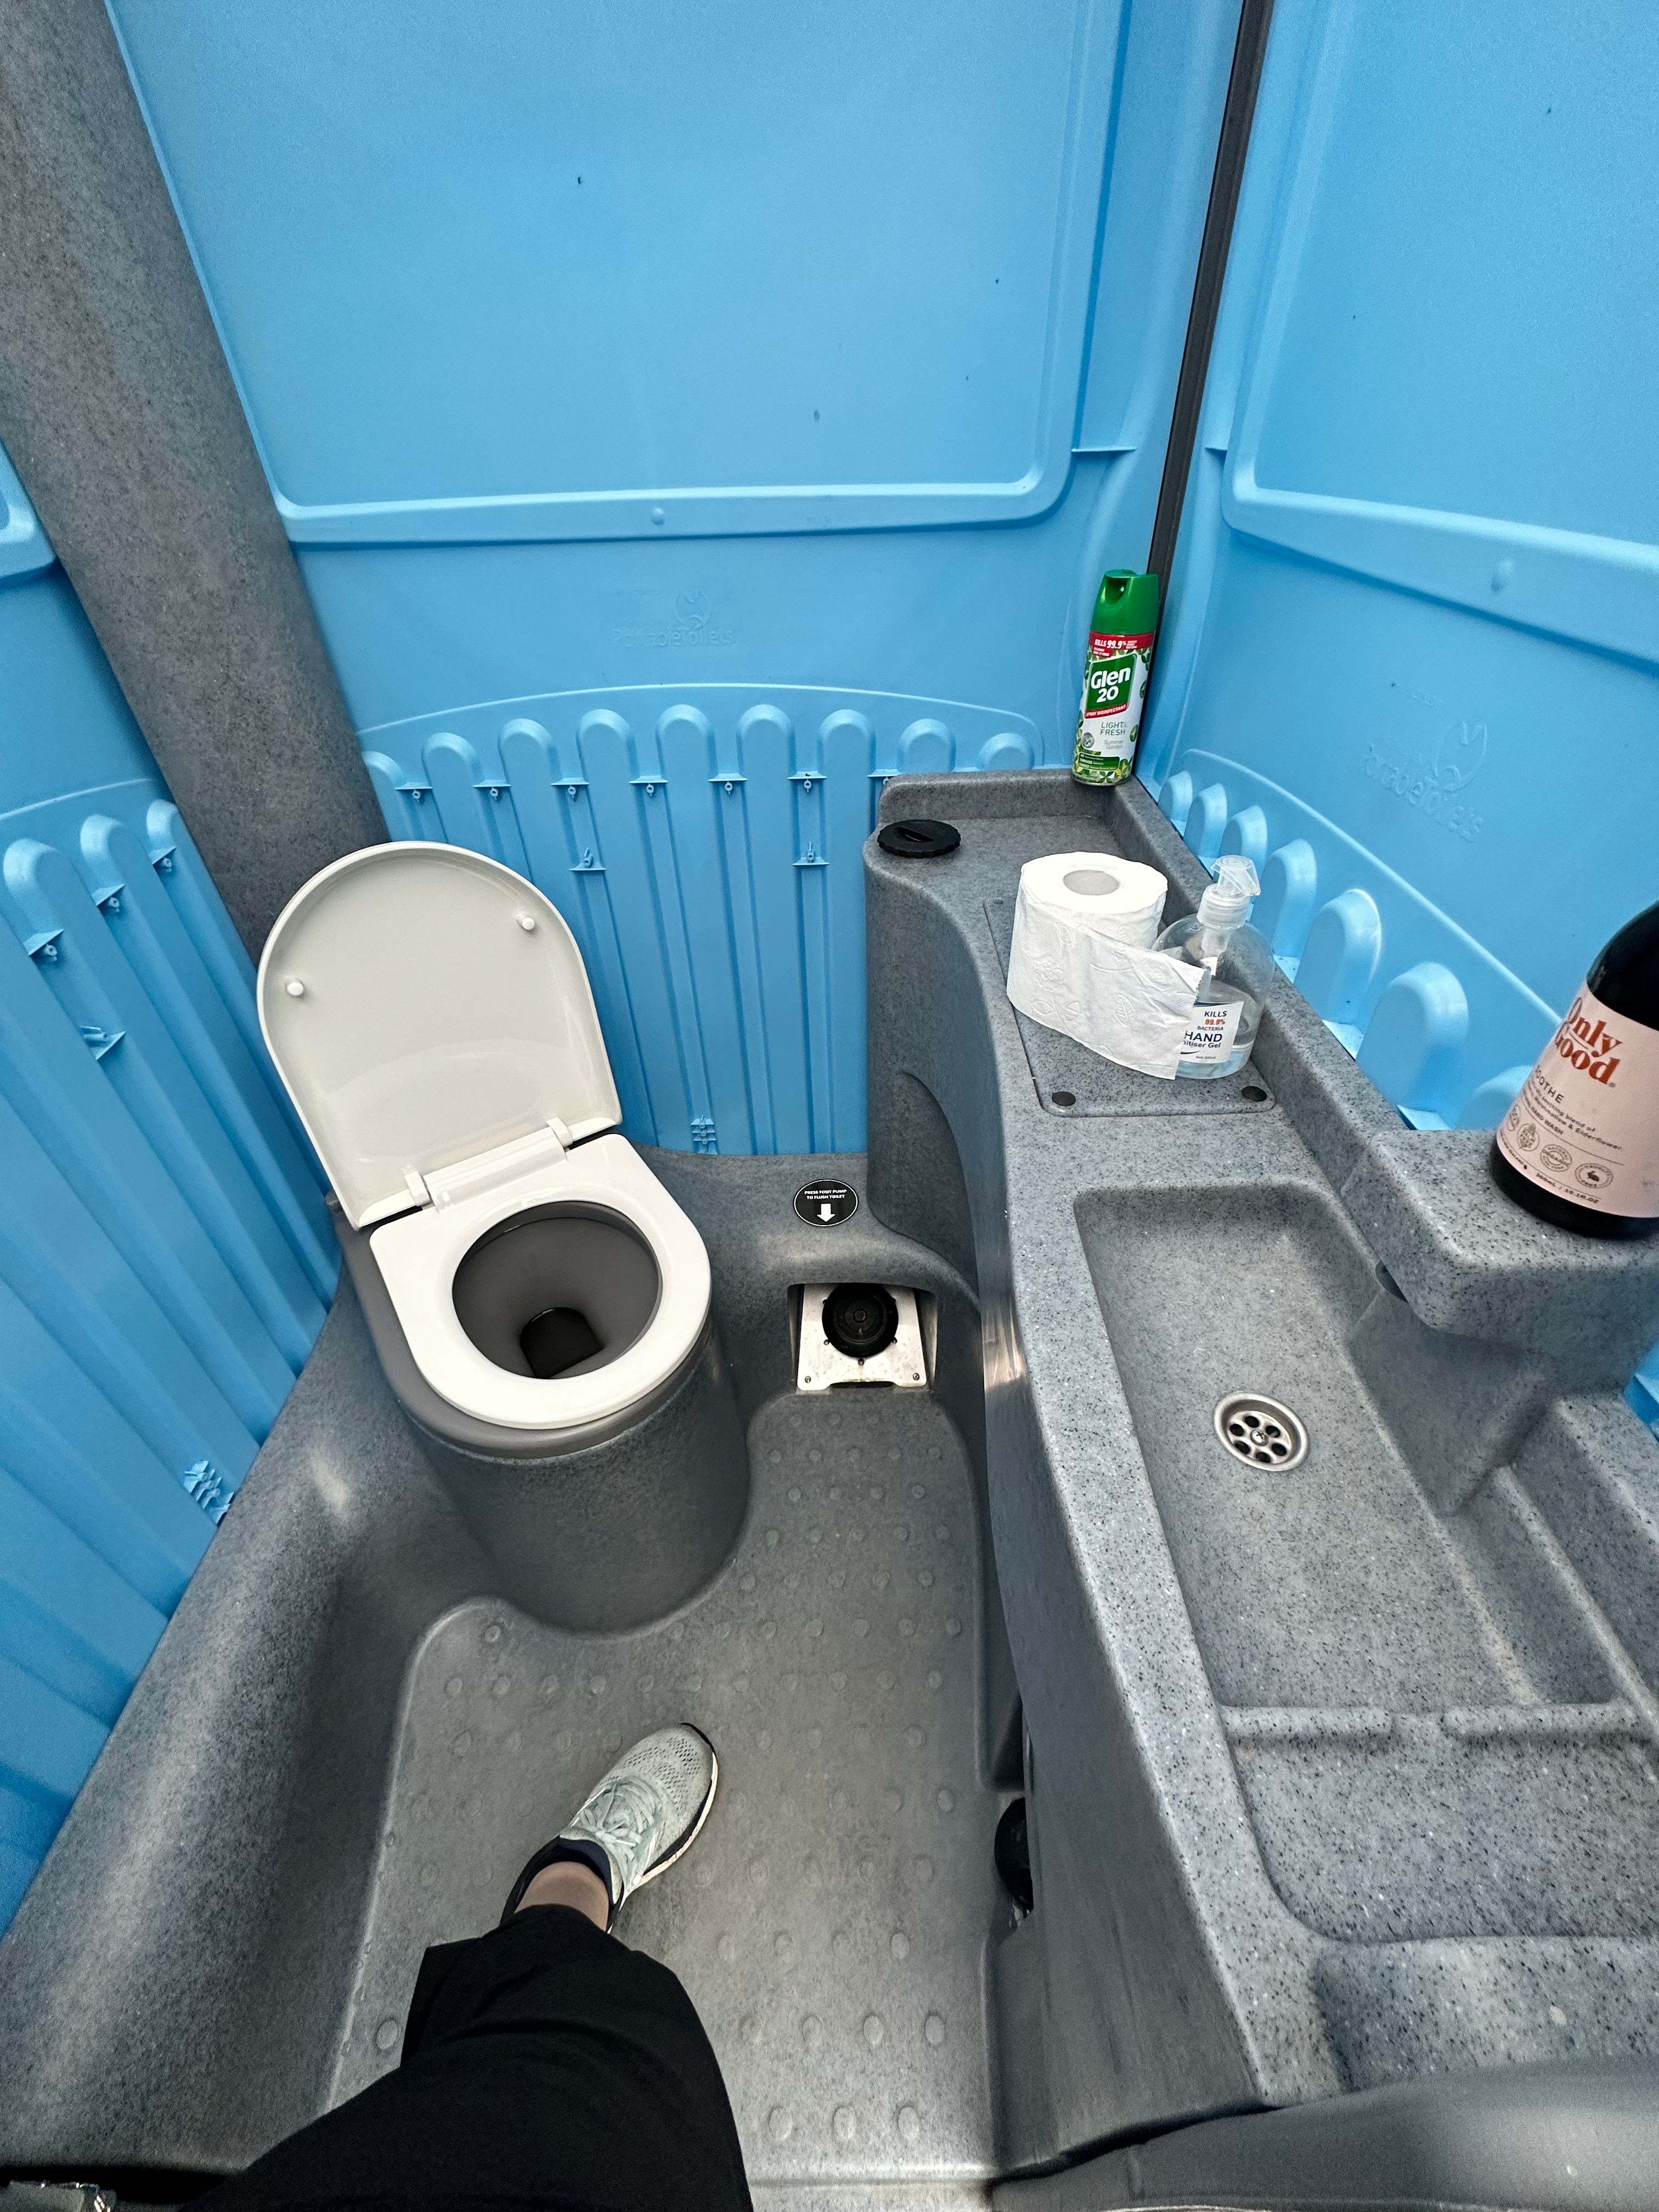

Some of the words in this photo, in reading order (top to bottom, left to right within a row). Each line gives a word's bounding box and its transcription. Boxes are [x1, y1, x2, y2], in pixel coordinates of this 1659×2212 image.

[1094, 639, 1107, 647] KILLS
[1091, 667, 1131, 689] Glen
[1096, 686, 1119, 703] 20
[1184, 1030, 1223, 1042] HAND
[1535, 1065, 1564, 1103] SOOTHE
